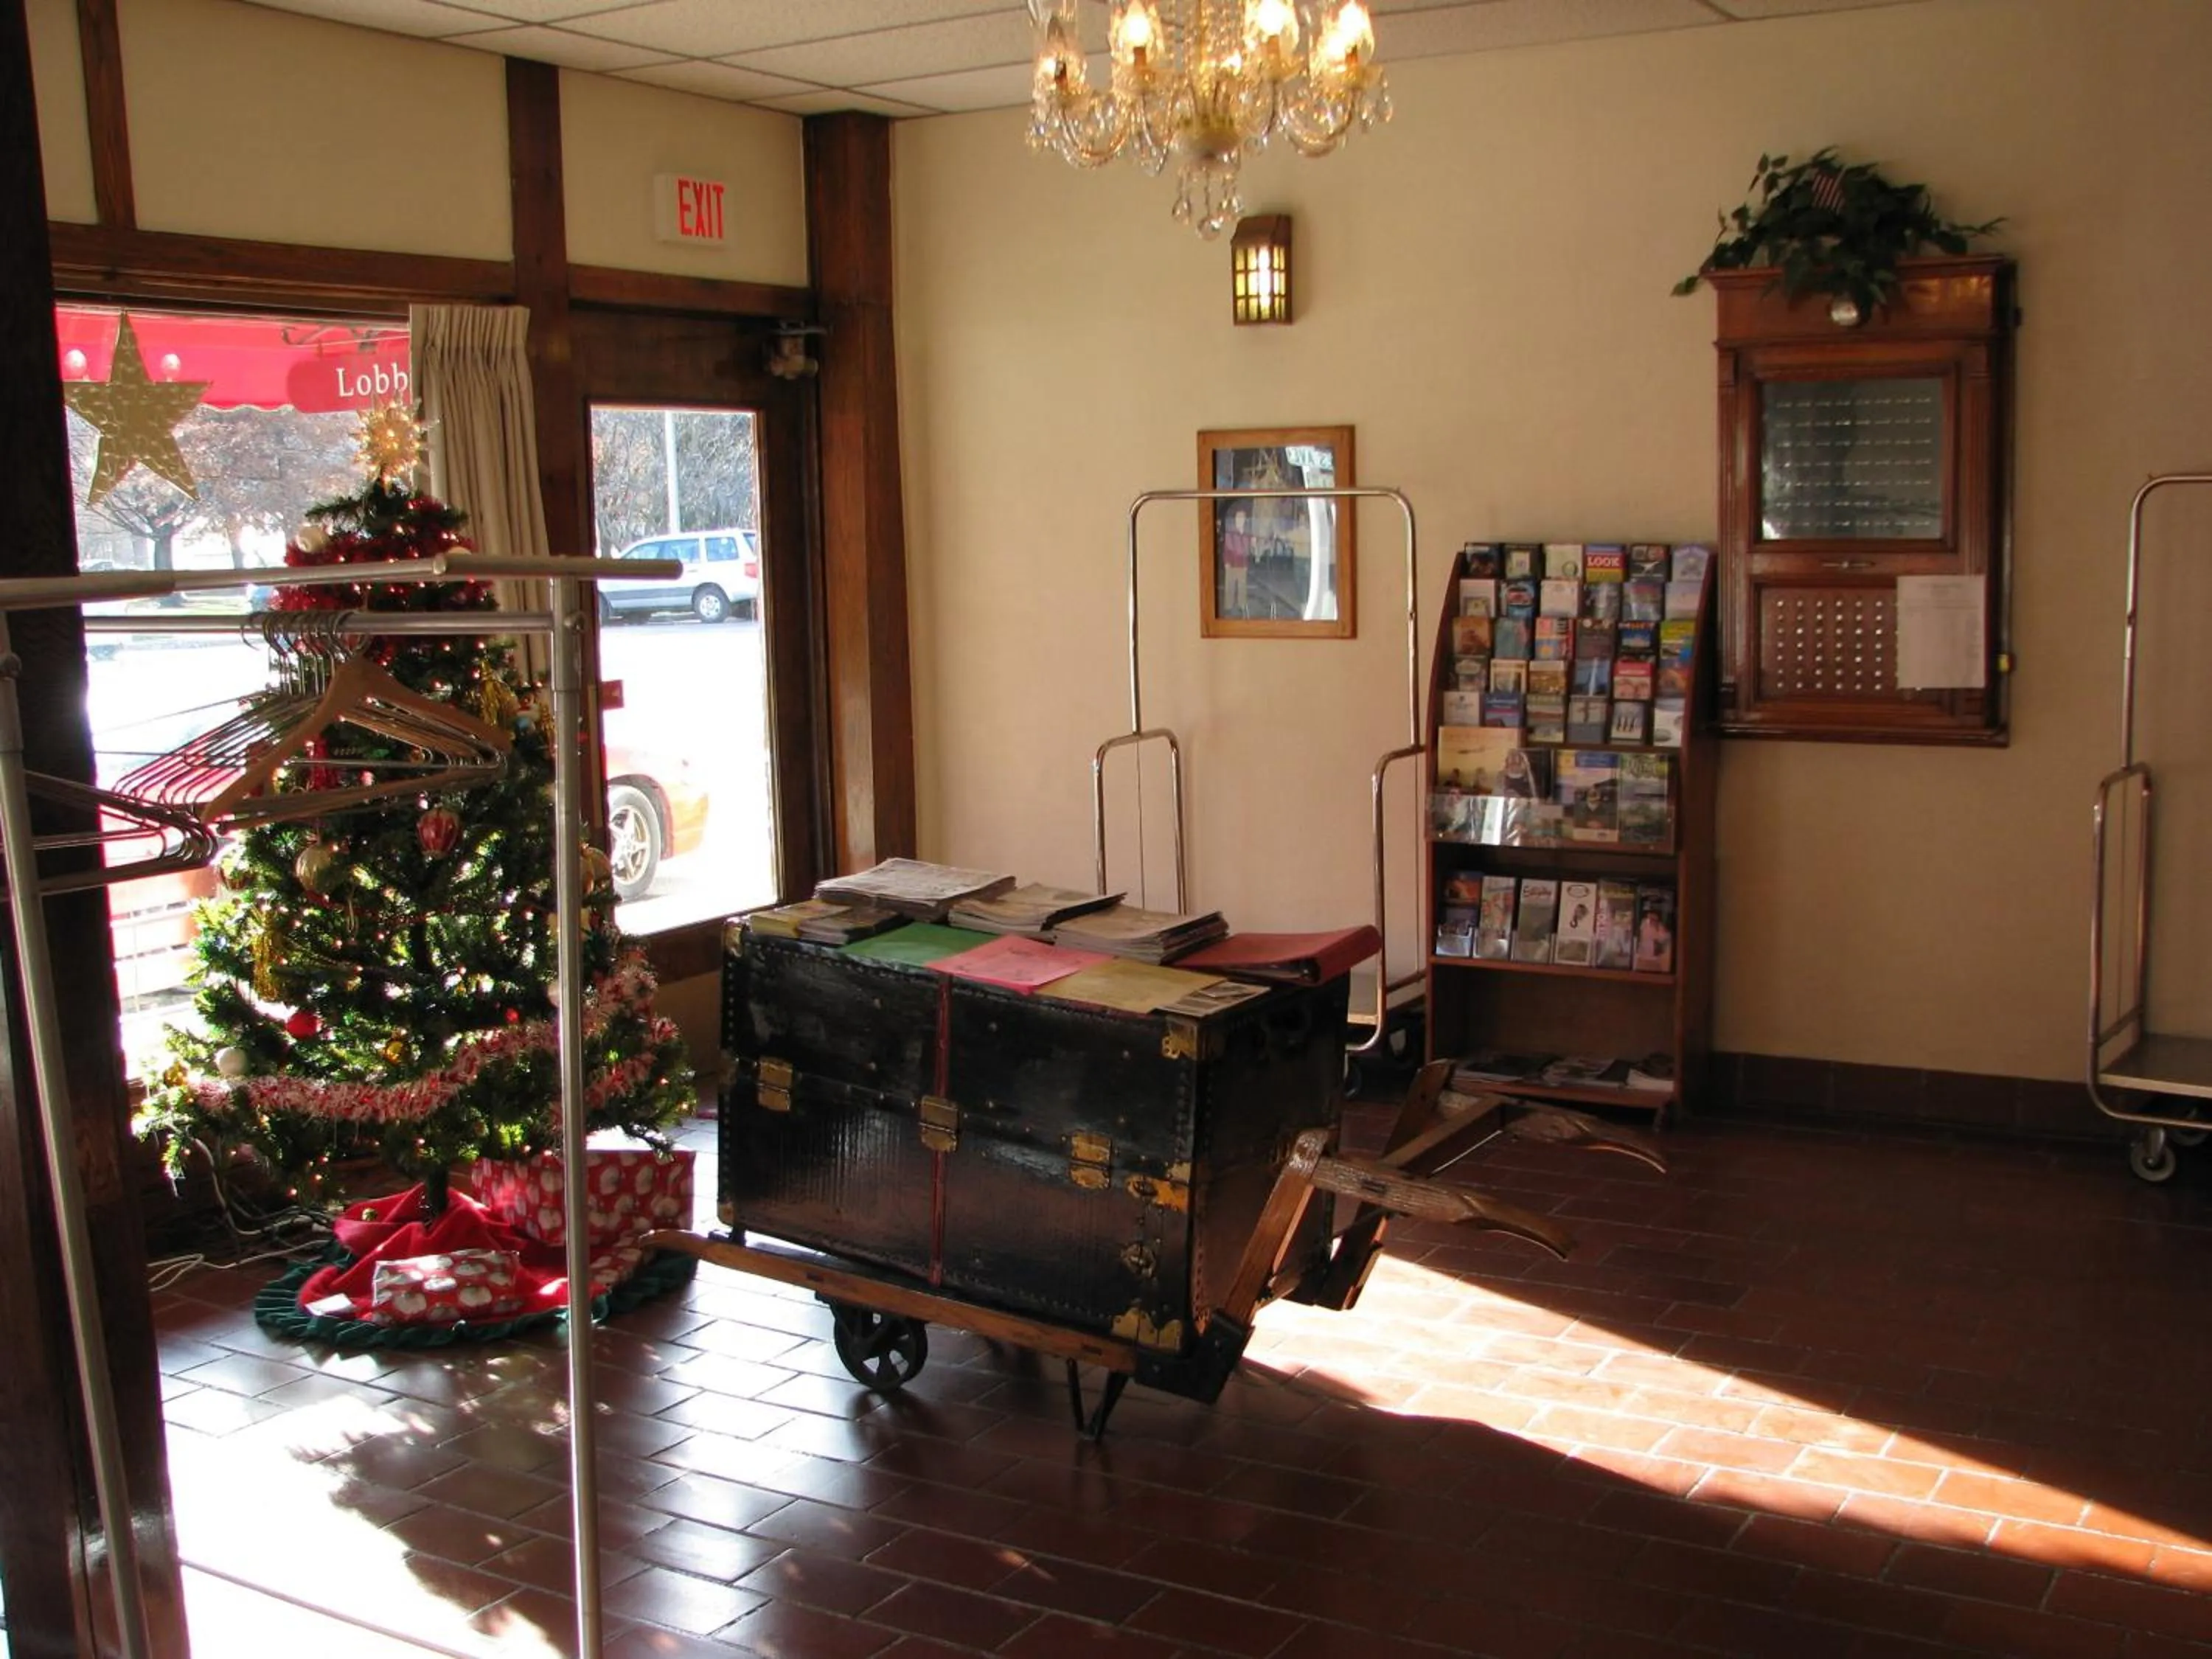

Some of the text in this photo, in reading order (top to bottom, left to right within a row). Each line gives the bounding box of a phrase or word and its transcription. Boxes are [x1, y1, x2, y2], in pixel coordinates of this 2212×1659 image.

[678, 179, 724, 239] EXIT
[336, 361, 408, 397] Lobb
[1587, 555, 1620, 567] LOOK
